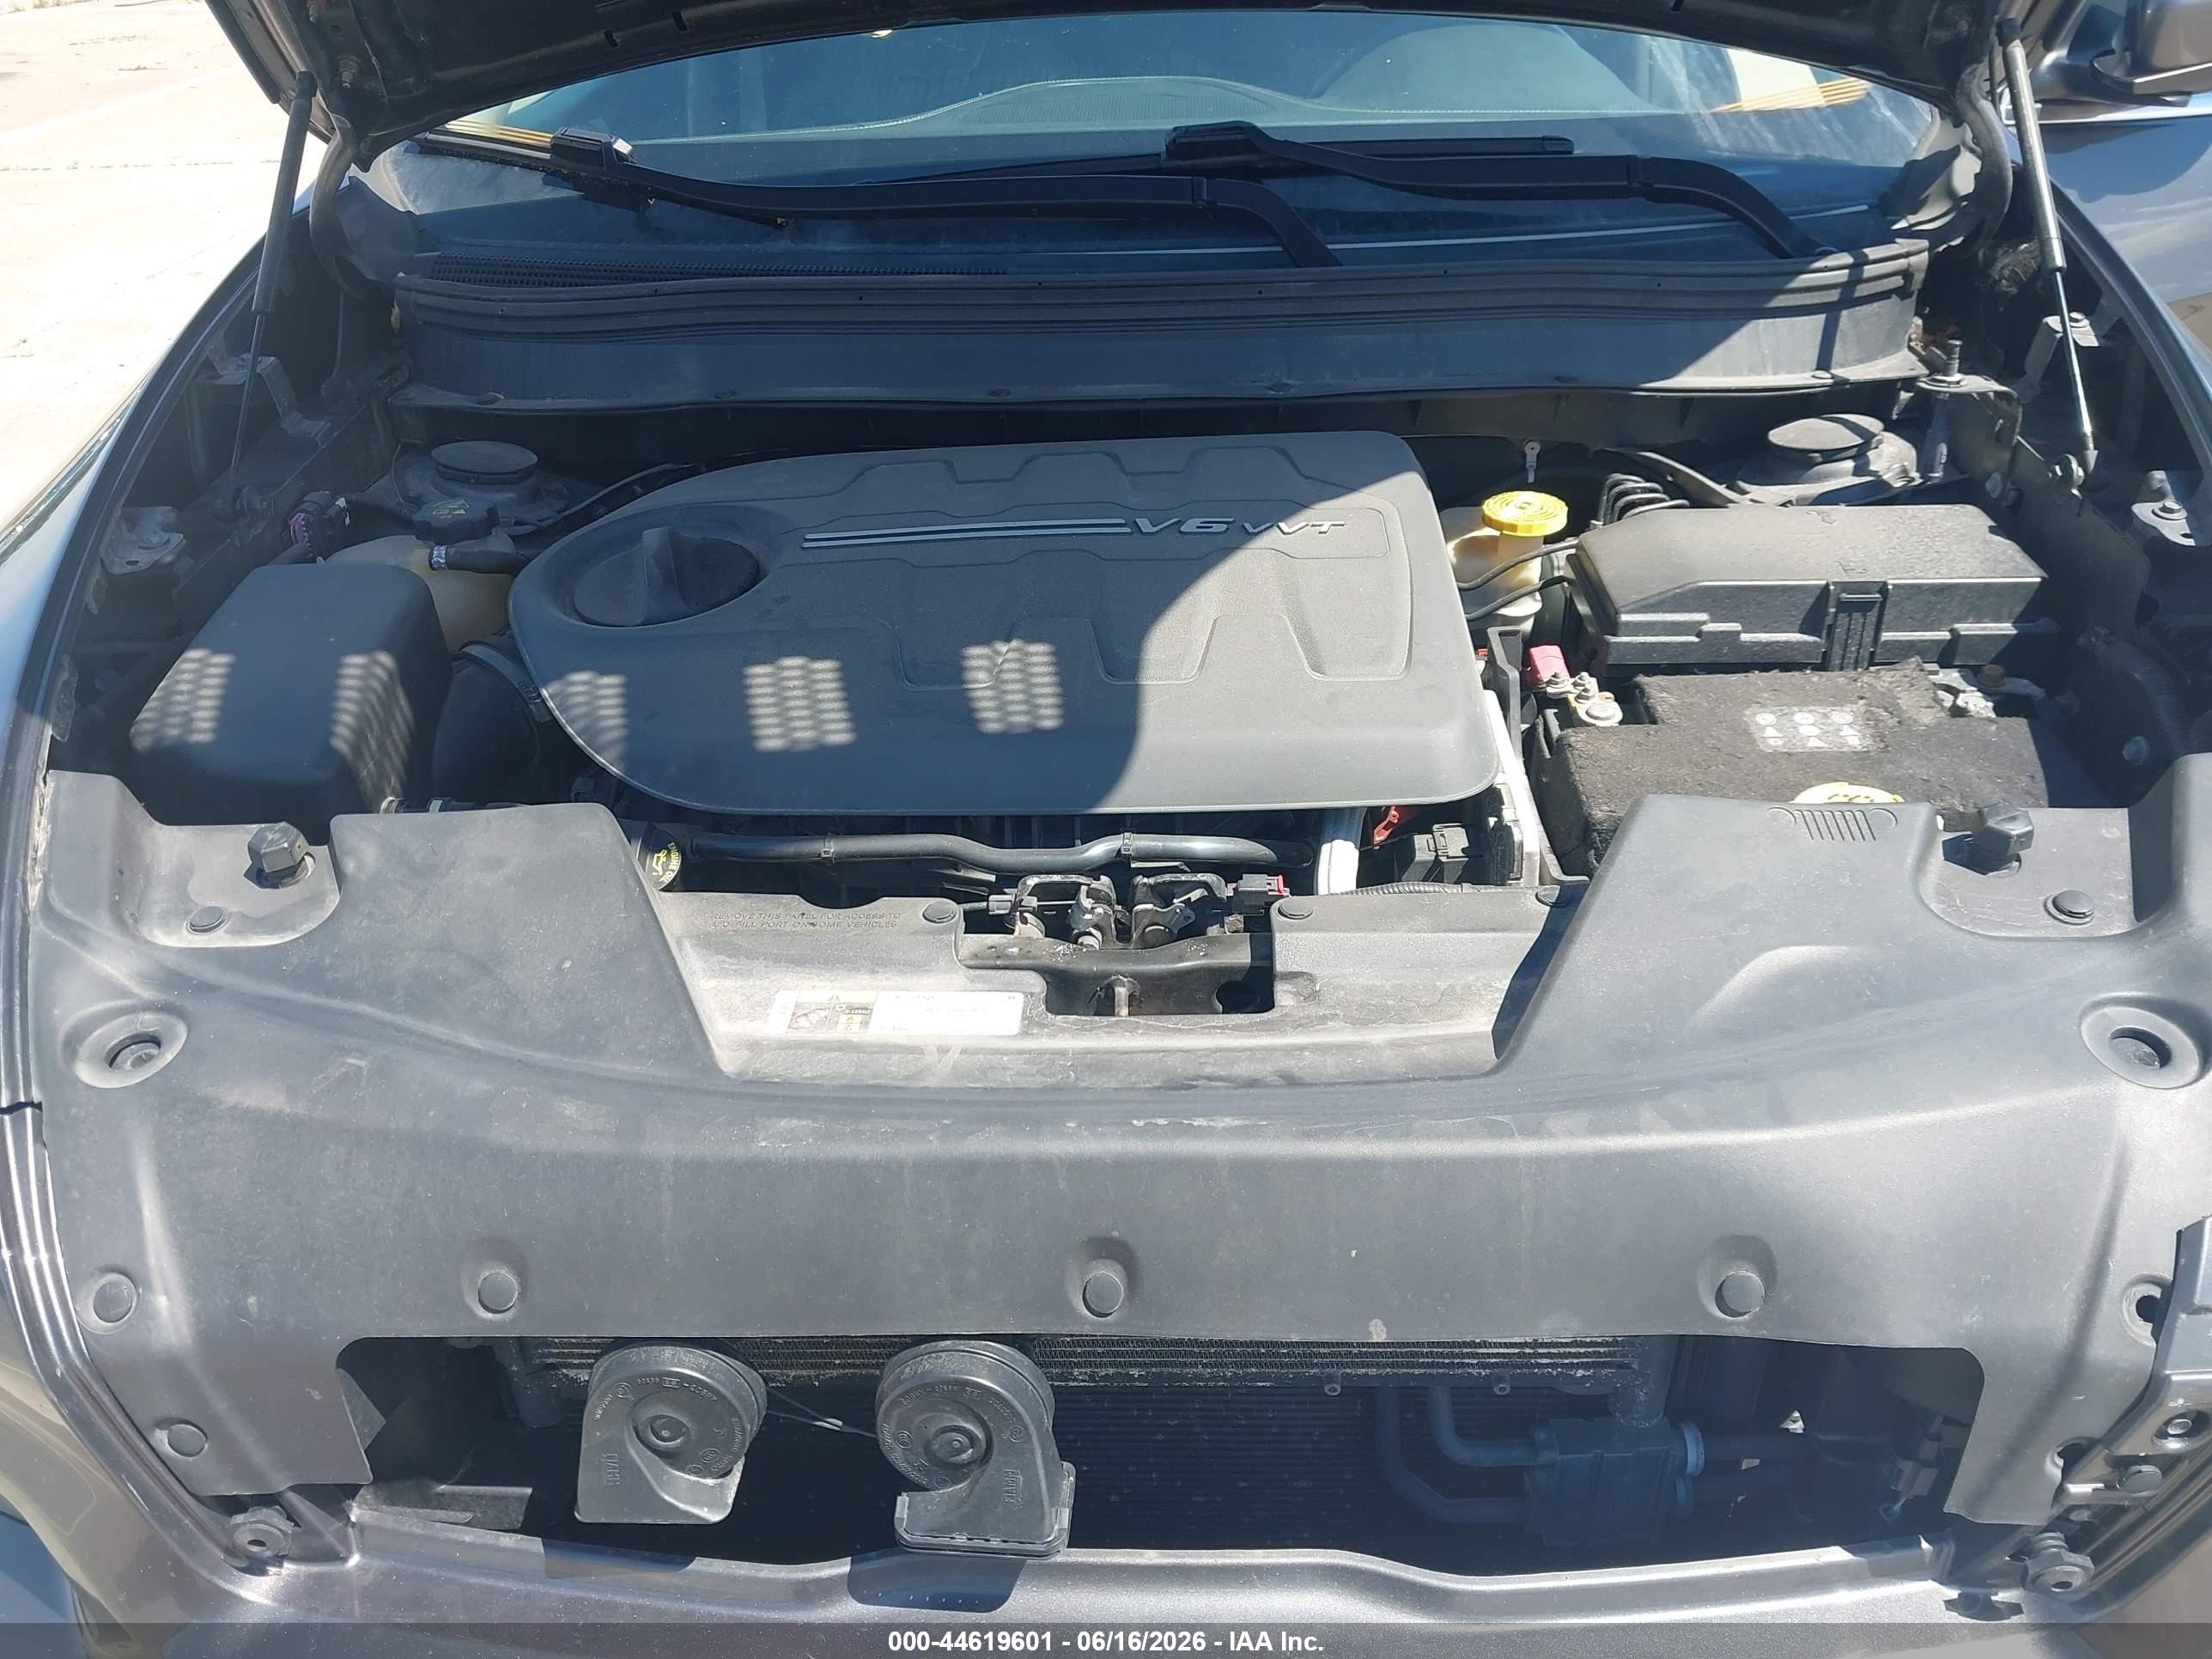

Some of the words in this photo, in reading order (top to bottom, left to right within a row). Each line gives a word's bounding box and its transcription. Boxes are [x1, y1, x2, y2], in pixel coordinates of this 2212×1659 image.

[1134, 518, 1234, 533] V6
[1243, 520, 1346, 535] VVT
[666, 842, 679, 871] ENGINE
[659, 871, 674, 884] OIL
